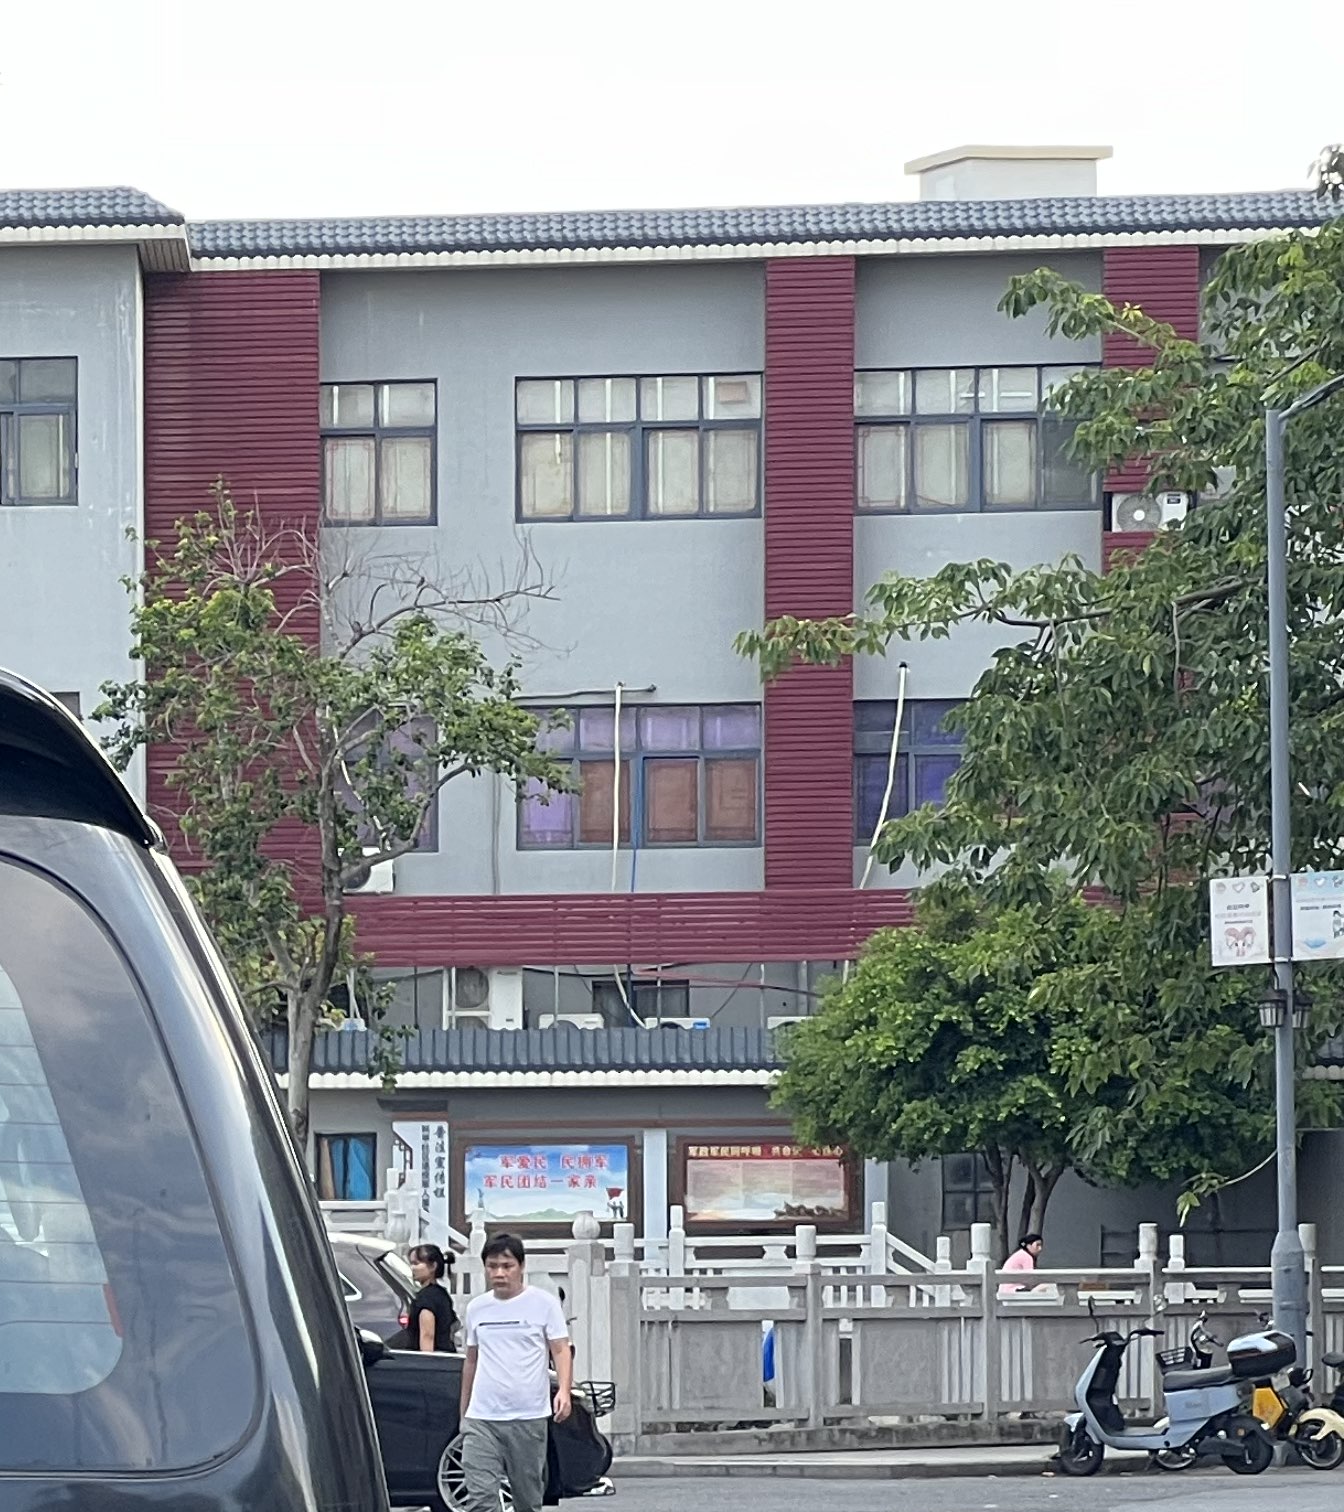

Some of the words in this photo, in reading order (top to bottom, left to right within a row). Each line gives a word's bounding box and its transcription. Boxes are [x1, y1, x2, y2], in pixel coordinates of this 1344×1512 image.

[500, 1154, 548, 1169] 军爱民
[562, 1154, 610, 1169] 民拥军
[483, 1174, 597, 1189] 军民团结一家亲
